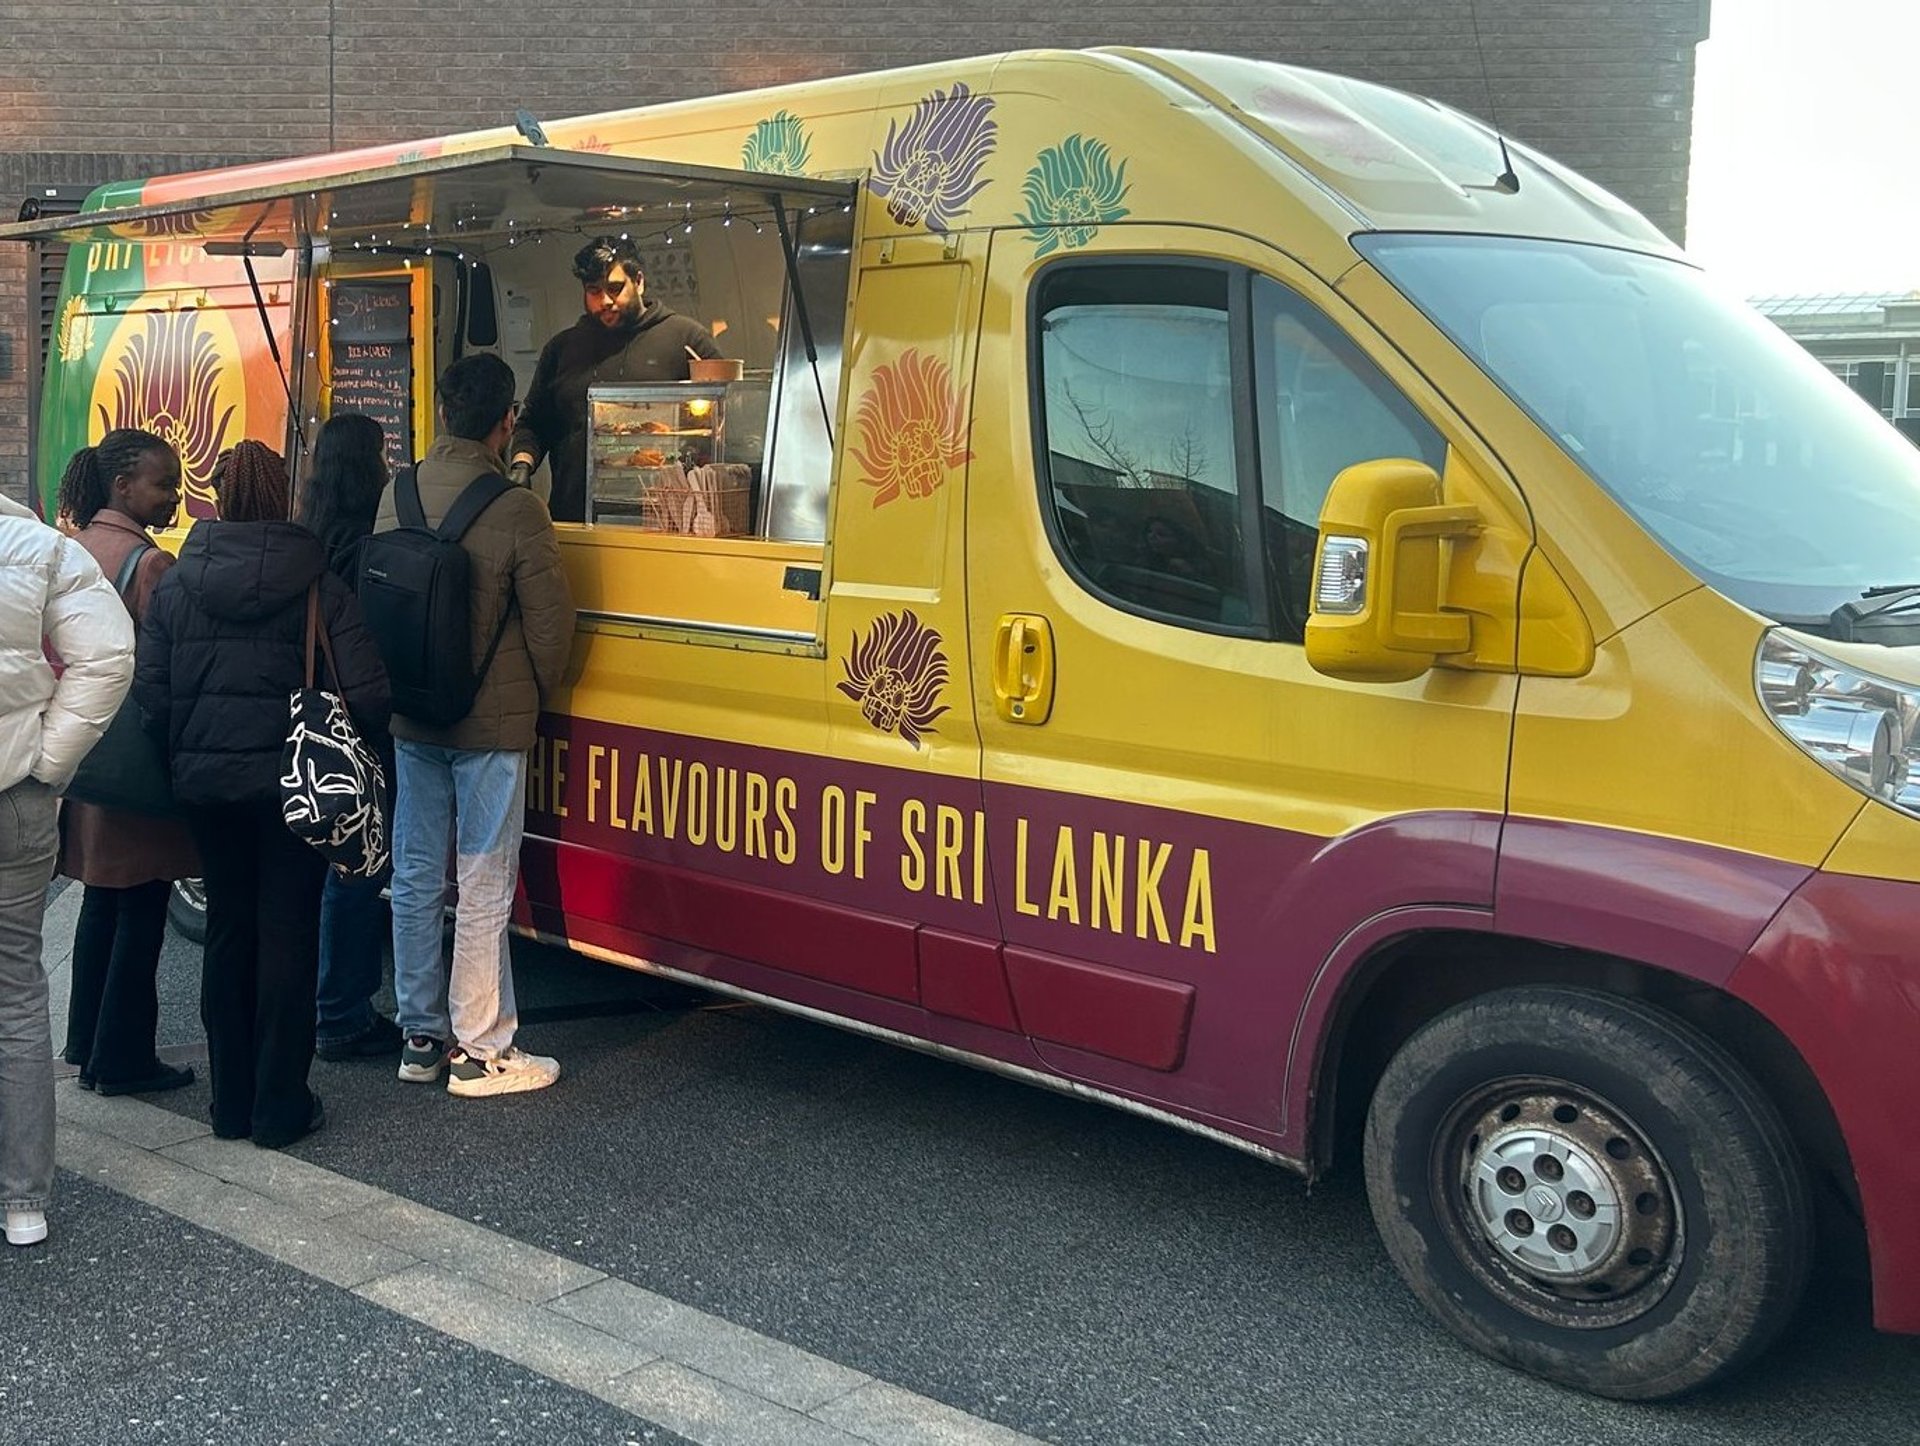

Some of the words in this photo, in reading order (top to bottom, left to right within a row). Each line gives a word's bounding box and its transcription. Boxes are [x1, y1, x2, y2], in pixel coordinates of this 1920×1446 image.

[587, 744, 798, 866] FLAVOURS
[820, 784, 877, 880] OF
[901, 798, 985, 905] SRI
[1015, 818, 1217, 954] LANKA
